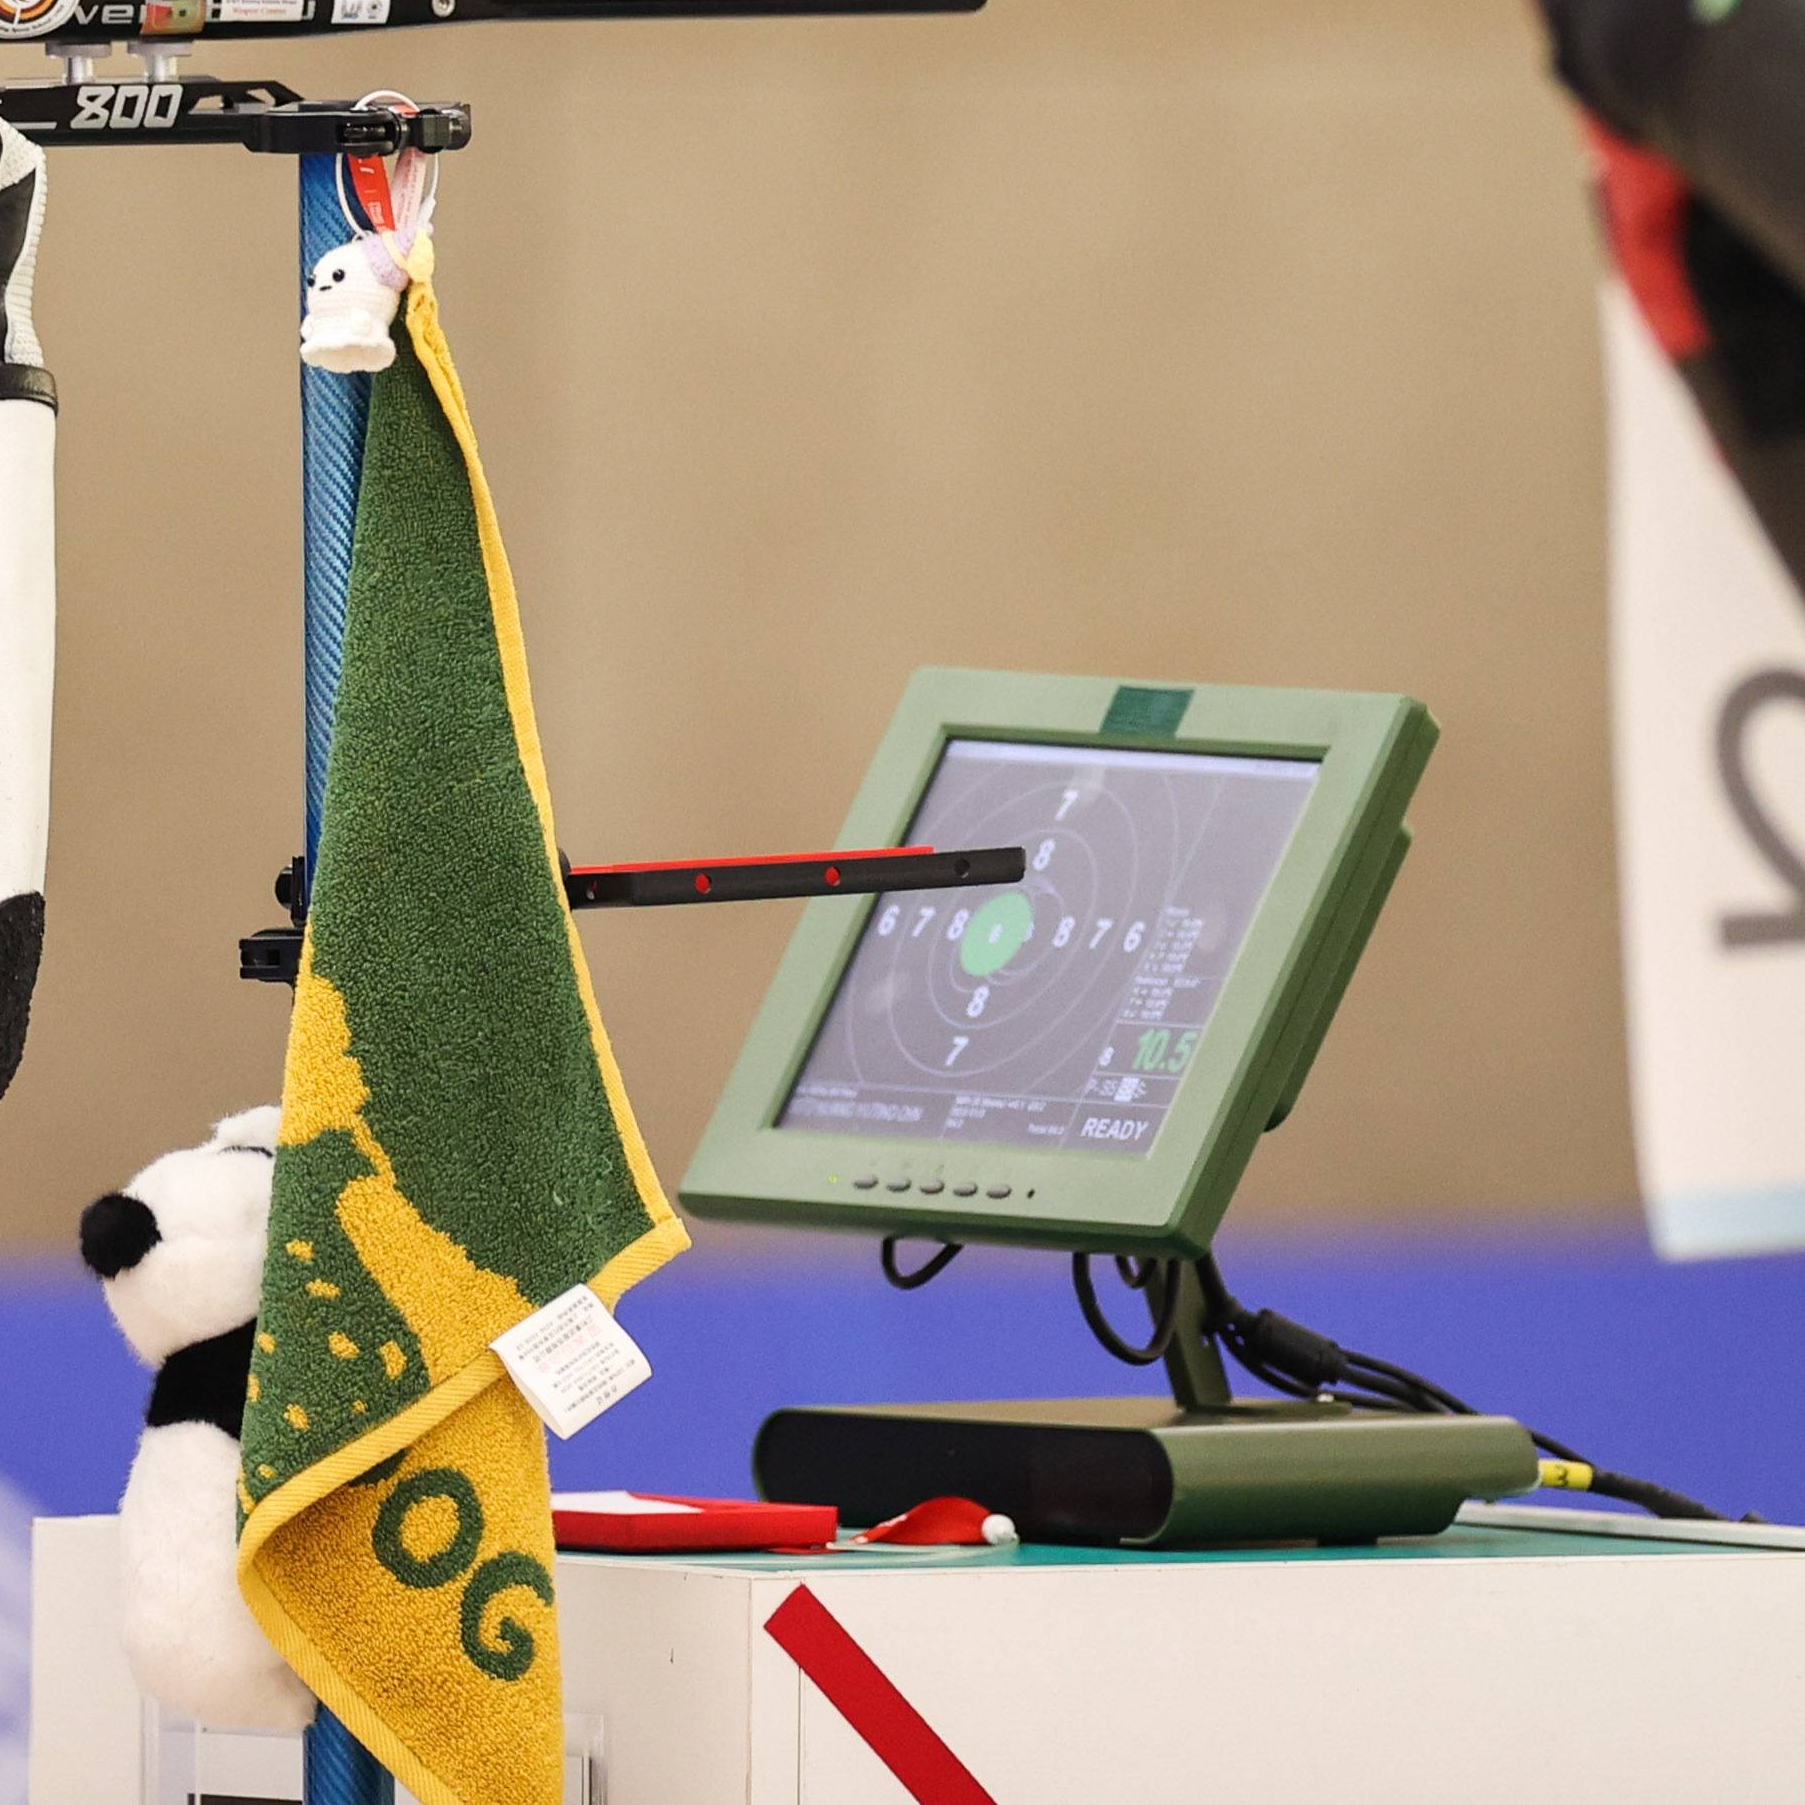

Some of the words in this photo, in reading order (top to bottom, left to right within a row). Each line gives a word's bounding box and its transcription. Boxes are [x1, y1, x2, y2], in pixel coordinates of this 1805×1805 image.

[70, 84, 183, 129] 800
[1054, 790, 1078, 821] 7
[1032, 838, 1055, 871] 8
[877, 905, 900, 936] 6
[912, 907, 936, 937] 7
[947, 909, 969, 941] 8
[1052, 916, 1075, 948] 8
[1089, 918, 1113, 949] 7
[1123, 921, 1145, 953] 6
[966, 986, 989, 1018] 8
[945, 1036, 969, 1066] 7
[1133, 1028, 1198, 1073] 10.5
[1081, 1116, 1148, 1140] READY
